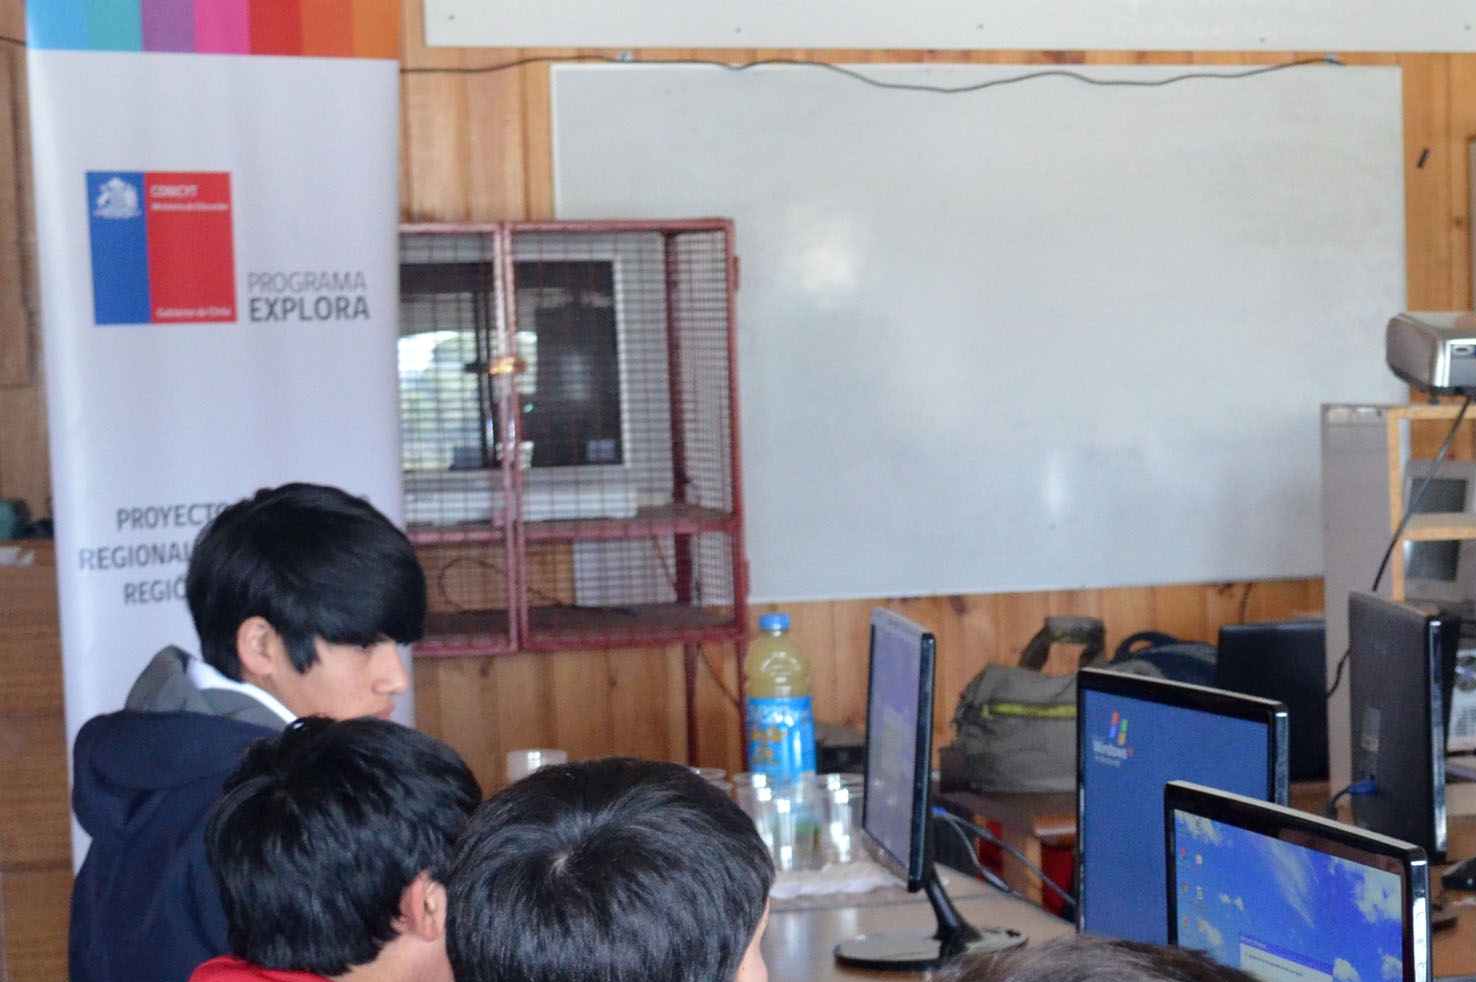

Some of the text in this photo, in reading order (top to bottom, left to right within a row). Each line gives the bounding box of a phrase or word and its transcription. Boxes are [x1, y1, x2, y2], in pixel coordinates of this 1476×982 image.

[248, 271, 368, 293] PROGRAMA
[249, 296, 370, 323] EXPLORA
[123, 573, 187, 604] REGIÓ
